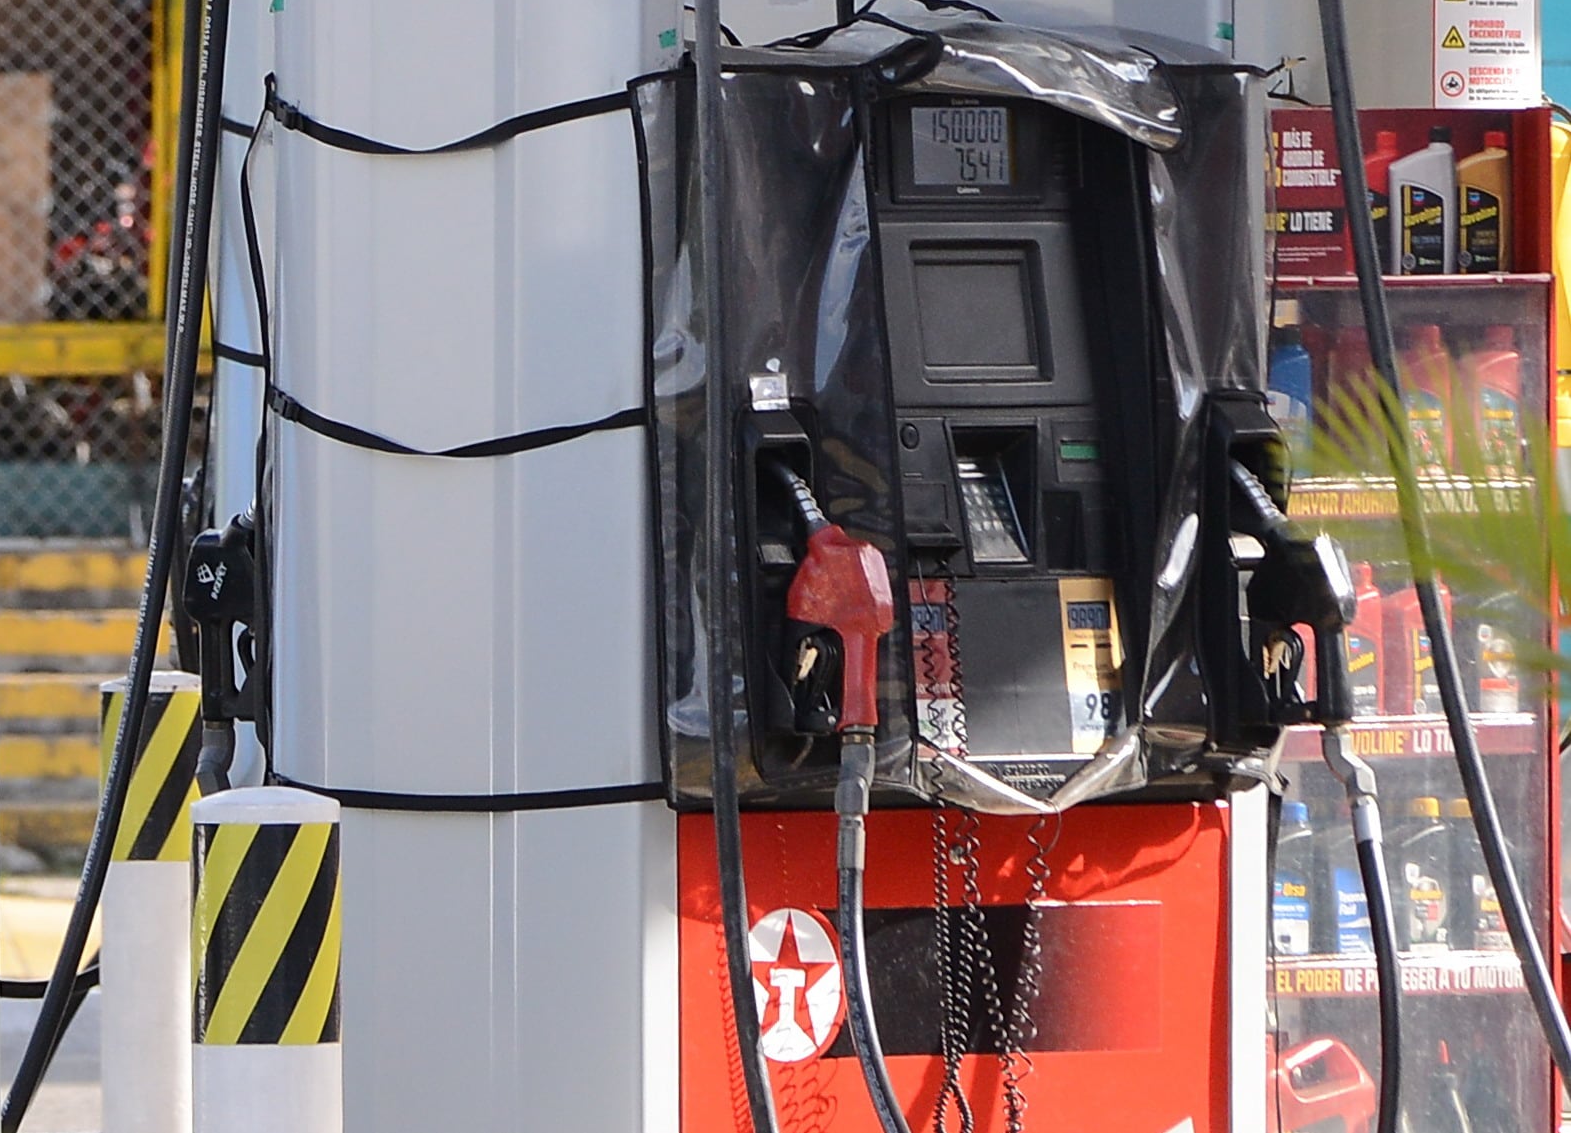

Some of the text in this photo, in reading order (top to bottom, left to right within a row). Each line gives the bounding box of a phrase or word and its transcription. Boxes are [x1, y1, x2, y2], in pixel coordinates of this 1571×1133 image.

[1469, 30, 1503, 38] ENCENDER
[199, 49, 209, 78] FUEL
[195, 79, 207, 138] DISPENSER
[932, 109, 1002, 144] 150000
[192, 141, 201, 174] STEEL
[189, 176, 198, 206] HOSE
[1289, 211, 1302, 232] LO
[1303, 211, 1333, 232] TIENE
[1085, 692, 1111, 720] 98
[1351, 729, 1406, 755] VOLINE
[1413, 729, 1429, 754] LO
[1276, 965, 1525, 993] EL PODER DE PEGER A TU MOTOR
